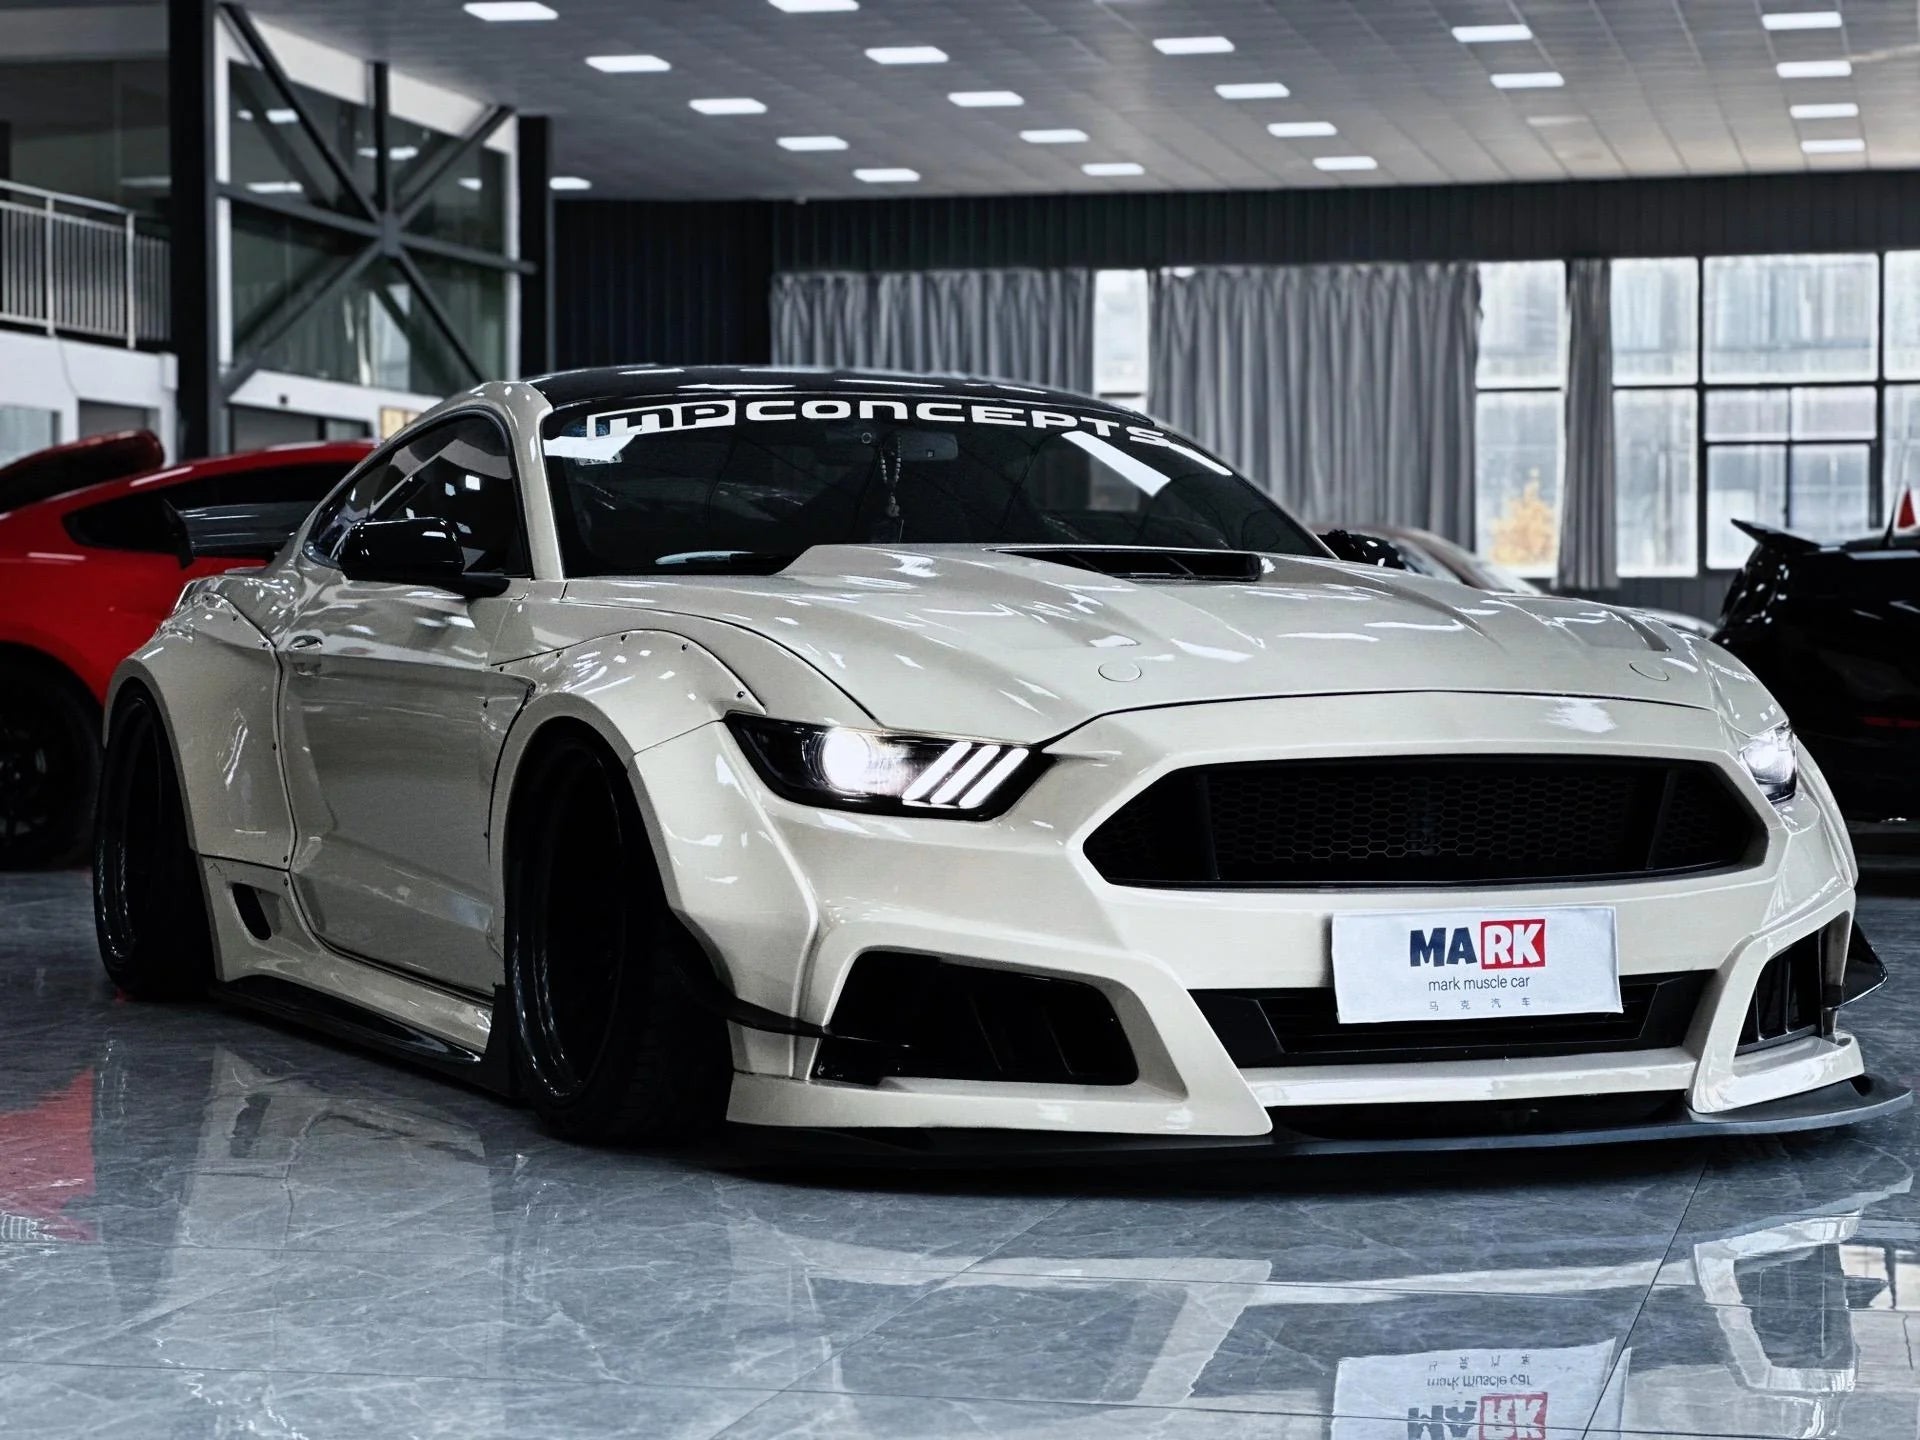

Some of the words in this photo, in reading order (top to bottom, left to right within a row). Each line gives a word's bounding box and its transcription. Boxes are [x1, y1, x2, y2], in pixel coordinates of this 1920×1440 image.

[1410, 923, 1543, 967] MARK
[1428, 977, 1461, 991] mark
[1464, 974, 1507, 990] muscle
[1510, 976, 1531, 988] car
[1429, 997, 1531, 1011] 马克汽车
